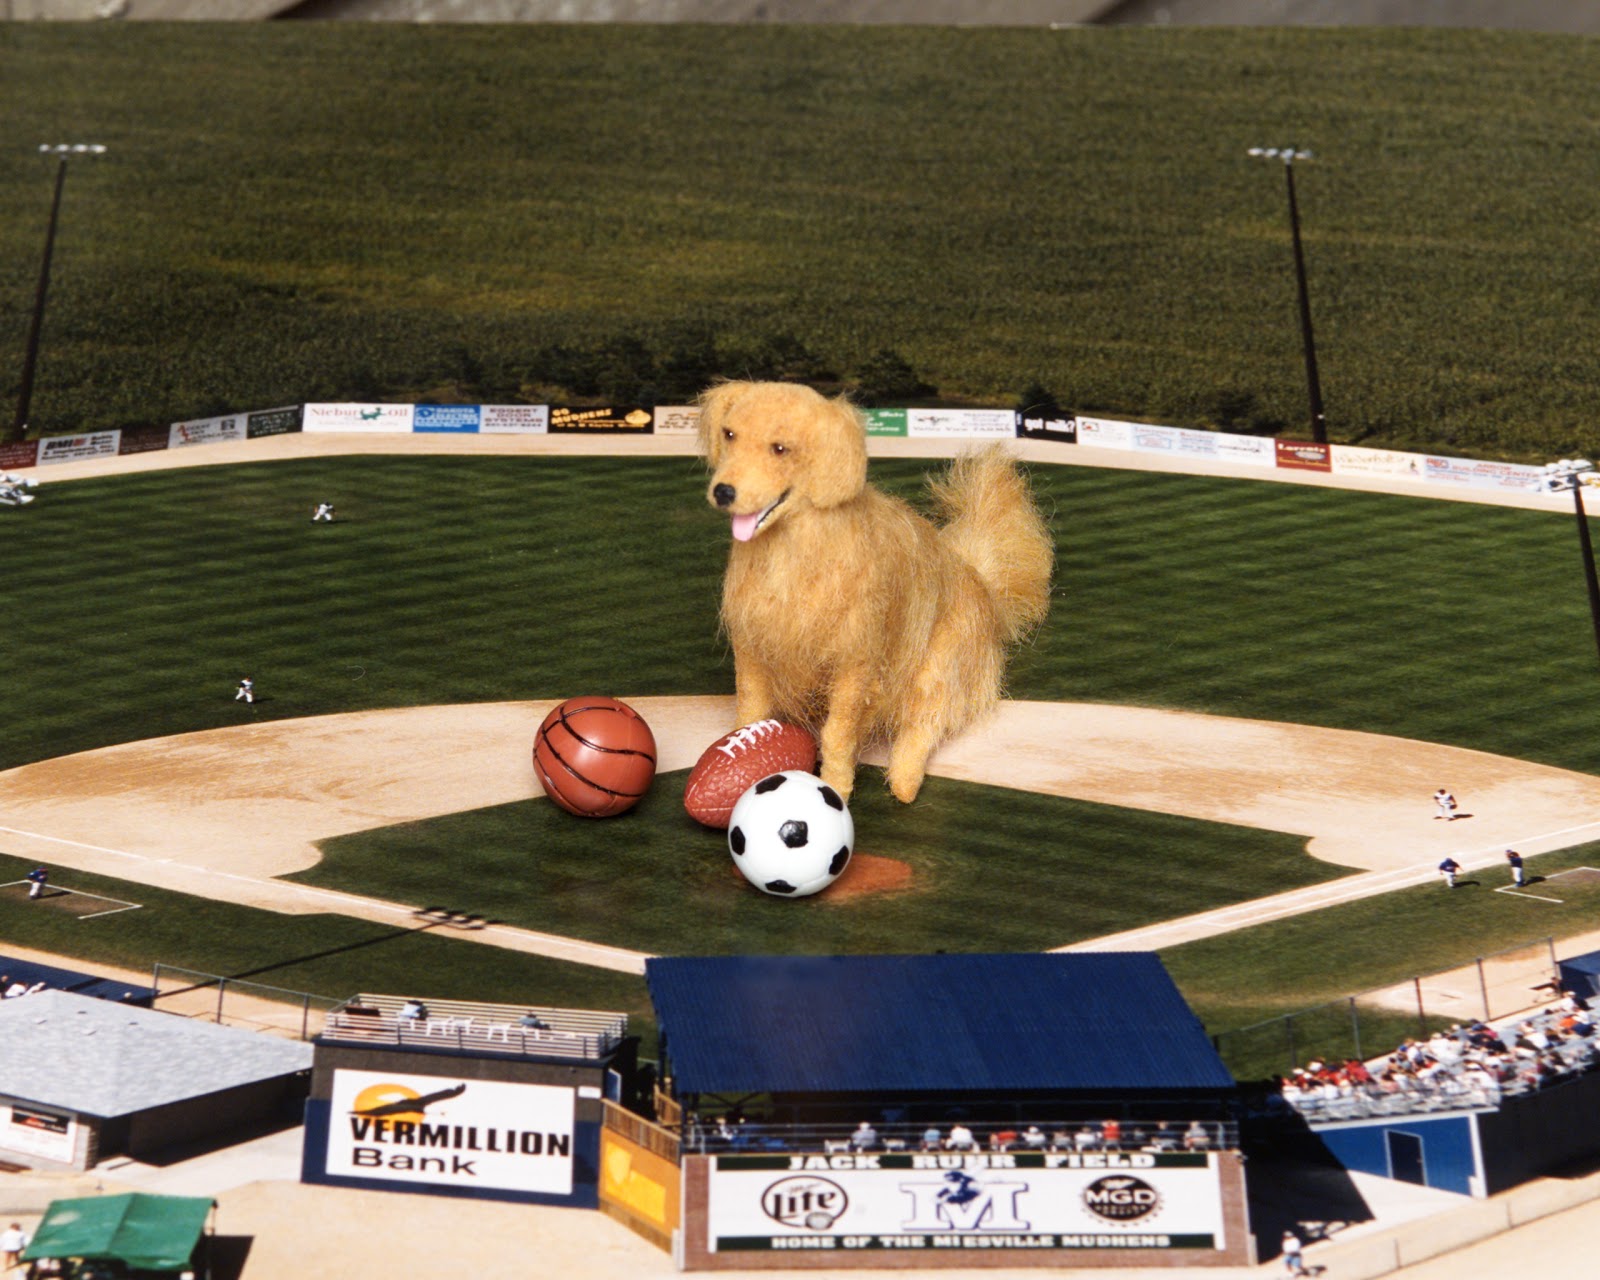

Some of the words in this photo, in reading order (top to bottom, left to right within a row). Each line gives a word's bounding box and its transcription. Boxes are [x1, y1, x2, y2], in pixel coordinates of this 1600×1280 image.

[388, 407, 408, 417] Oil
[551, 408, 612, 425] MUDHENS
[1024, 418, 1044, 431] got
[1045, 418, 1076, 434] milk?
[349, 1116, 570, 1157] VERMILLION
[352, 1147, 478, 1176] Bank
[788, 1155, 882, 1170] JACK
[1044, 1154, 1156, 1168] FIELD
[1086, 1188, 1157, 1204] MGD
[772, 1190, 836, 1221] Lite
[771, 1236, 836, 1249] HOME
[842, 1236, 873, 1248] OF
[878, 1236, 926, 1248] THE
[1061, 1235, 1171, 1247] MUDHENS
